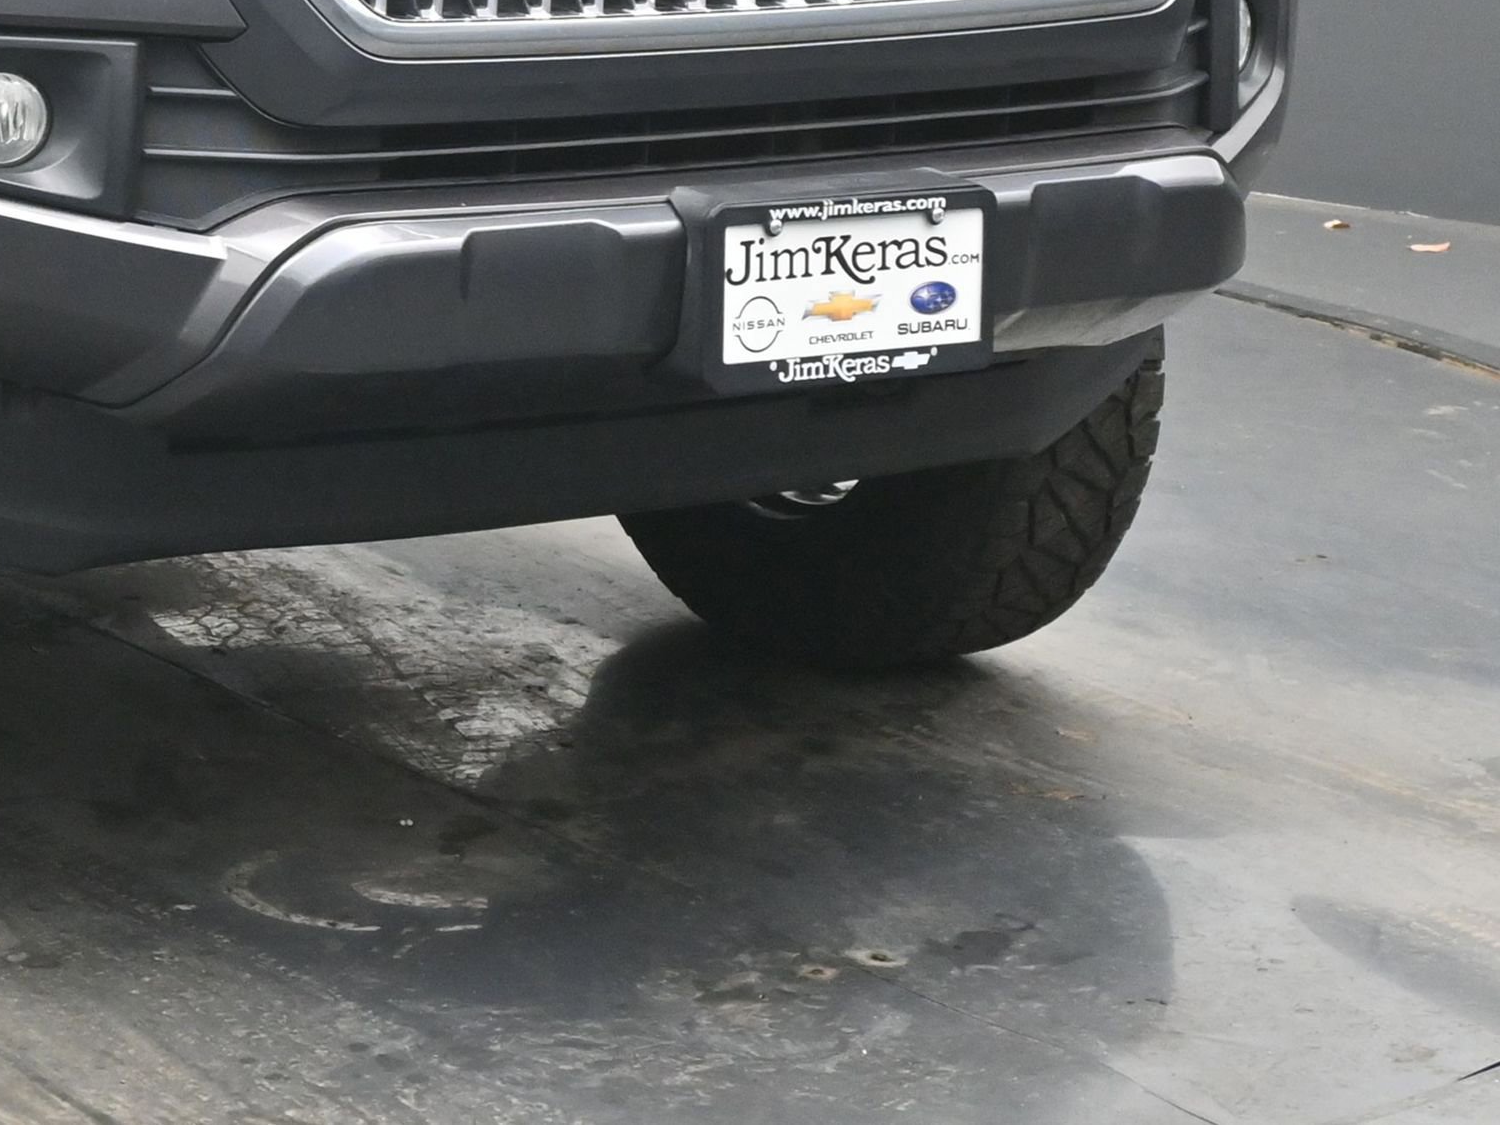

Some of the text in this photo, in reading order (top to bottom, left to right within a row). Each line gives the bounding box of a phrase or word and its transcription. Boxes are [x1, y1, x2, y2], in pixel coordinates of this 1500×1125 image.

[769, 196, 947, 221] www.jimkeras.com
[732, 316, 786, 331] NISSAN
[897, 318, 969, 335] SUBARU
[808, 330, 875, 345] CHEVROLET
